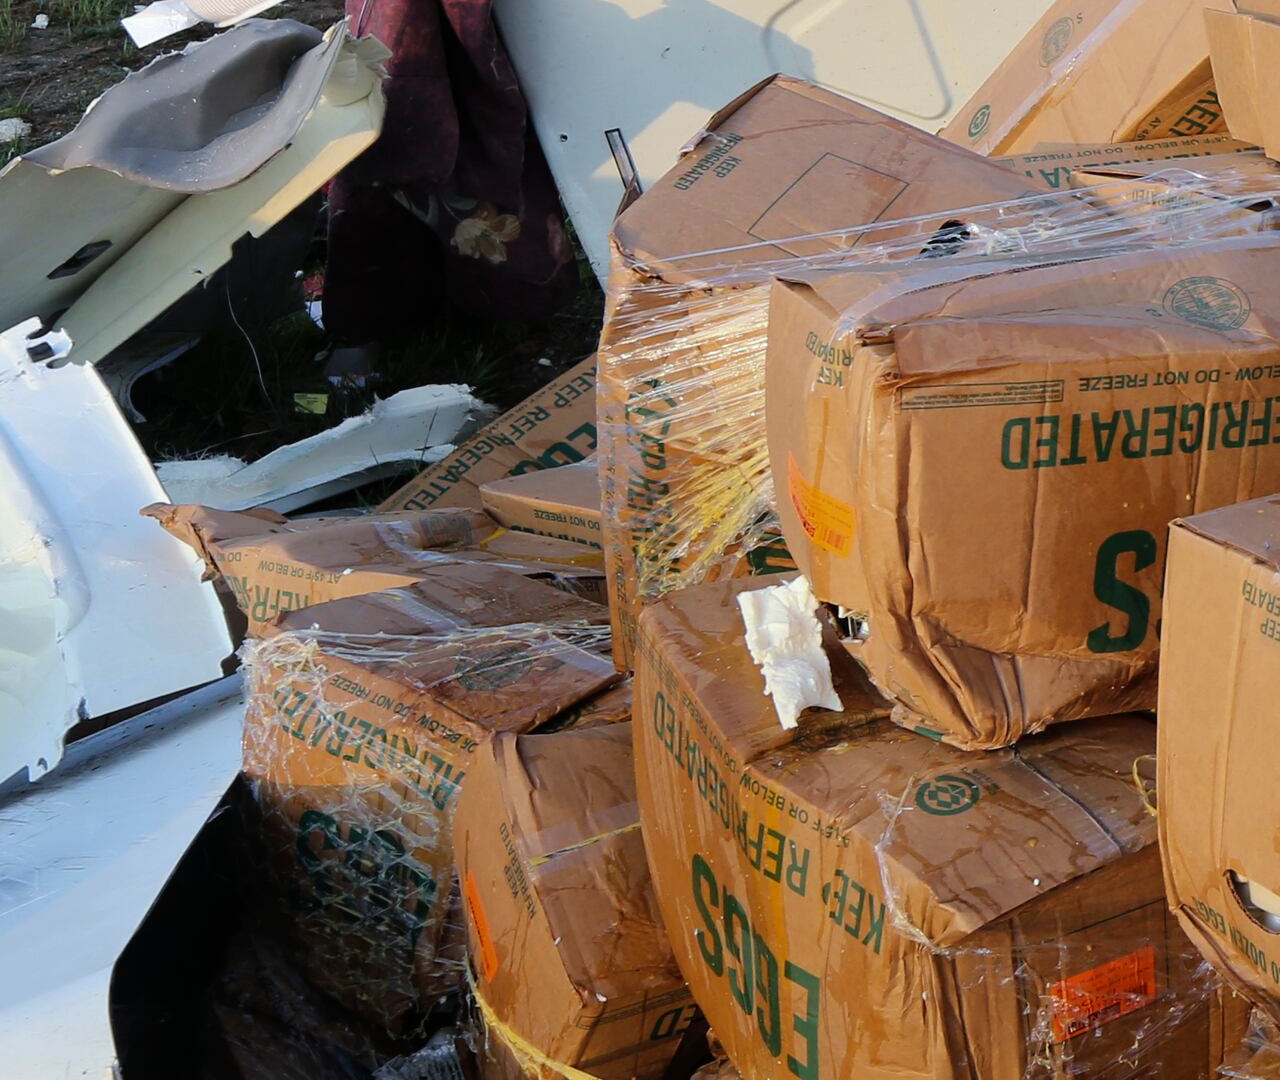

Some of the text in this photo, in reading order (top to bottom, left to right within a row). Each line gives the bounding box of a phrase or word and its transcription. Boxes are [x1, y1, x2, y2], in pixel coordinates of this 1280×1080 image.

[1075, 148, 1102, 160] NOT
[716, 156, 743, 179] KEEP
[1079, 374, 1149, 393] FREEZE
[1153, 370, 1191, 387] NOT
[1194, 368, 1222, 385] DO
[533, 508, 568, 523] FREEZE
[569, 516, 587, 529] NOT
[257, 559, 290, 577] BELOW
[290, 568, 305, 582] OR
[326, 572, 342, 585] AT
[329, 673, 371, 698] FREEZE
[370, 689, 394, 710] NOT
[654, 690, 812, 897] REFRIGERATED
[740, 772, 786, 811] BELOW
[788, 804, 810, 822] OR
[499, 822, 537, 920] REFRIGERATED
[504, 865, 519, 900] KEEP
[1228, 929, 1268, 972] DOZEN
